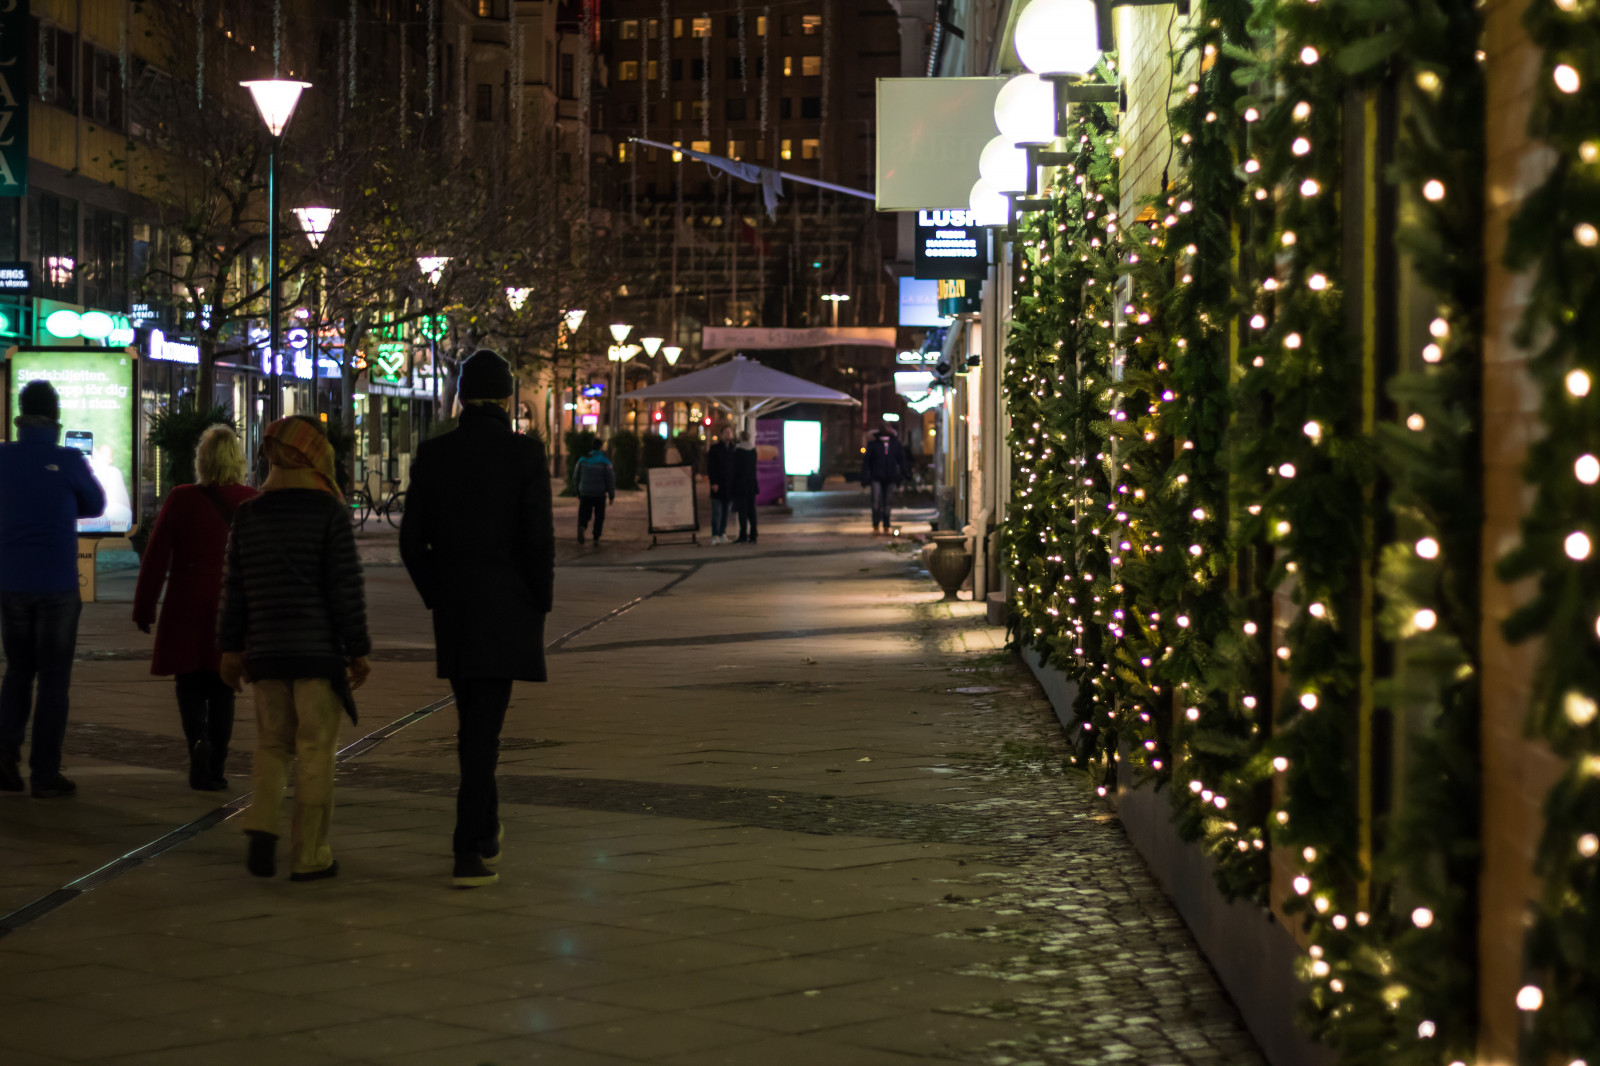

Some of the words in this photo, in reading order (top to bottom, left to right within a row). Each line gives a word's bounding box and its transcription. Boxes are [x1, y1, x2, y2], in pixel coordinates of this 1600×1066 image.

[919, 209, 984, 227] LUSH
[0, 269, 25, 279] ERGS
[105, 384, 128, 398] dig
